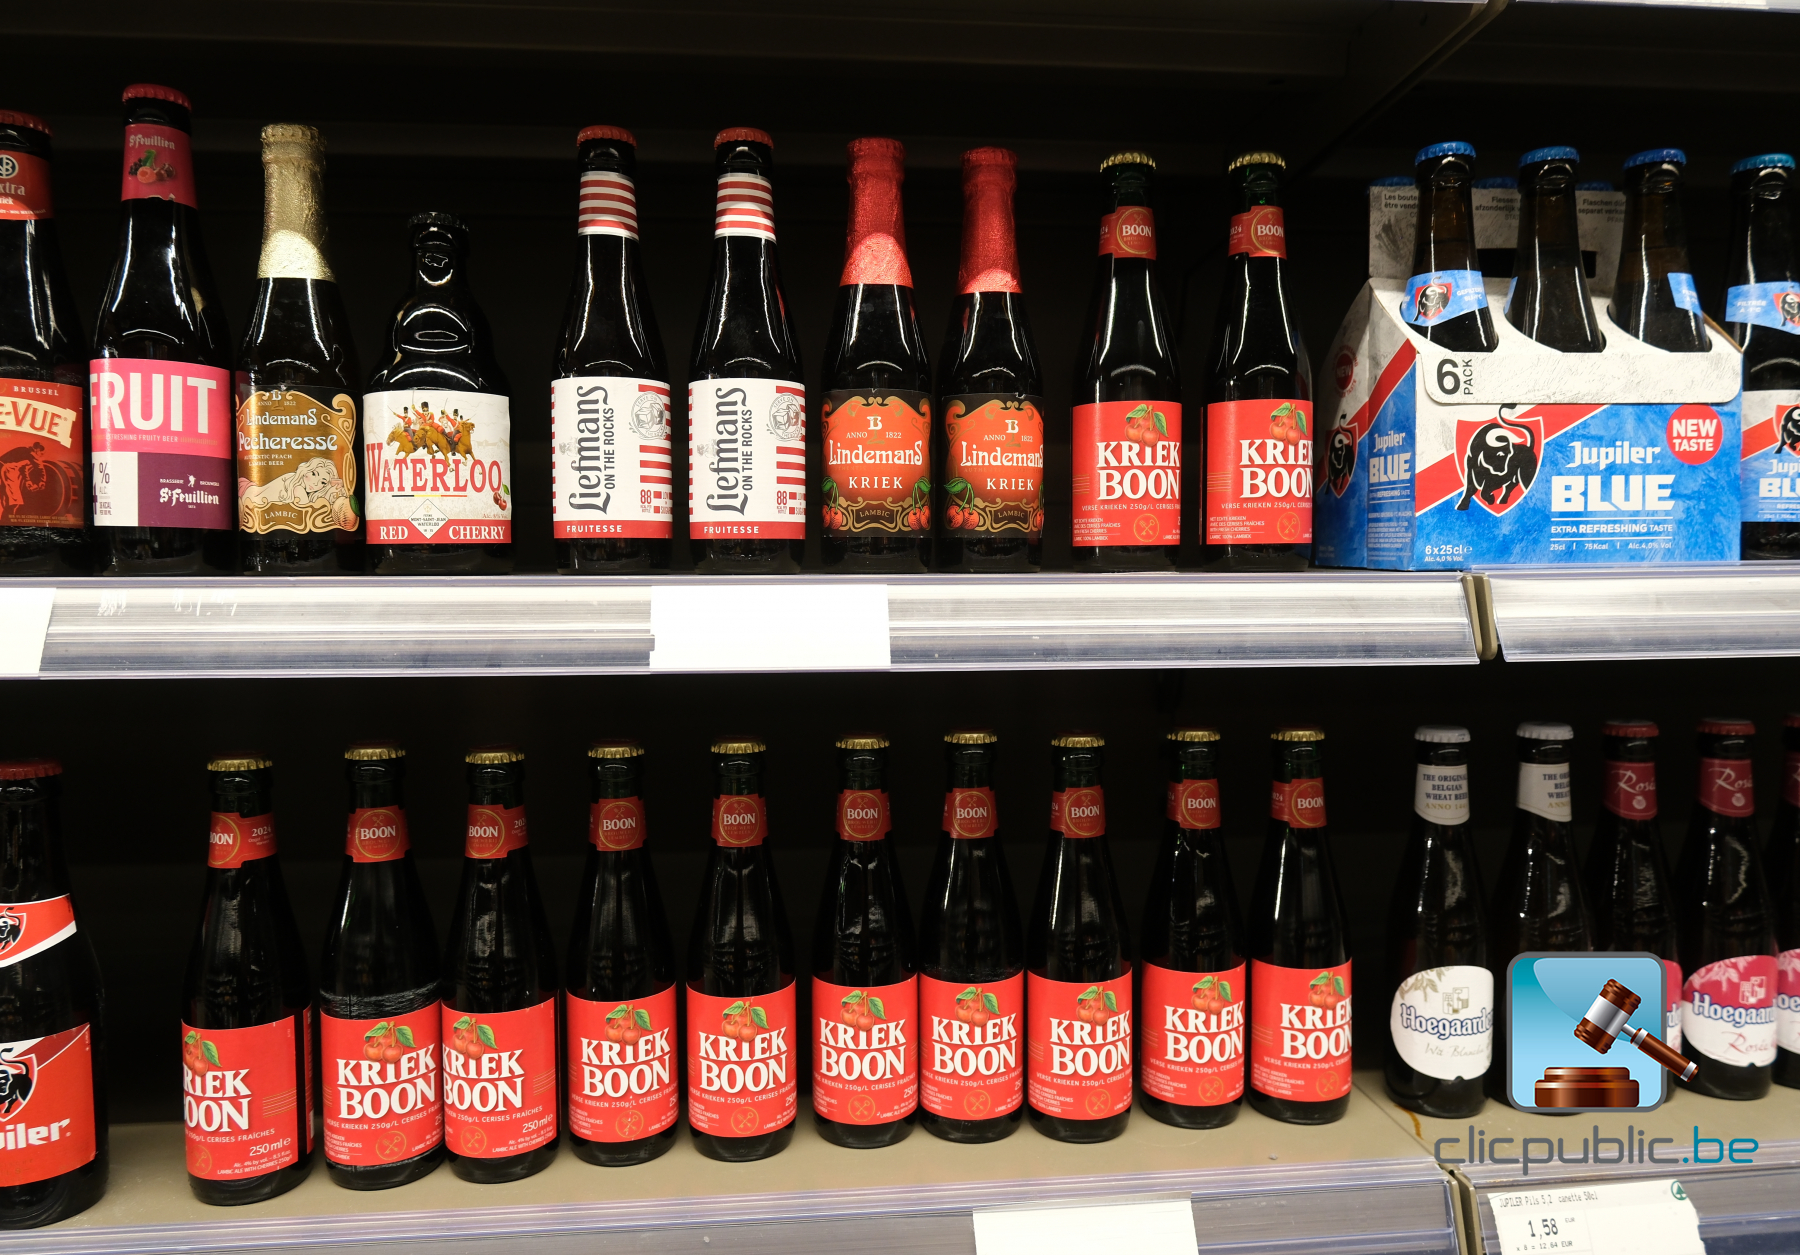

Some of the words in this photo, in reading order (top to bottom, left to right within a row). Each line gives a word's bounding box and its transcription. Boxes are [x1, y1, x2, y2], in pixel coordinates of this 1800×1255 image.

[1475, 205, 1516, 213] afzonderlijk
[1122, 224, 1151, 237] BOON
[1257, 224, 1284, 237] BOON
[1436, 359, 1461, 395] 6
[1463, 358, 1473, 395] PACK
[13, 386, 59, 396] BRUSSEL
[90, 372, 217, 434] FRUIT
[603, 407, 615, 445] ROCKS
[741, 409, 753, 447] ROCKS
[1672, 419, 1717, 437] NEW
[1373, 431, 1405, 453] Jupiler
[1673, 439, 1714, 452] TASTE
[569, 386, 611, 515] Liefmans
[706, 387, 748, 516] Liefmans
[1096, 441, 1180, 467] KRIEK
[1565, 441, 1661, 471] Jupiler
[366, 443, 502, 493] WATERLOO
[604, 450, 615, 471] THE
[742, 451, 753, 472] THE
[1369, 452, 1411, 484] BLUE
[604, 474, 616, 490] ON
[742, 475, 753, 491] ON
[848, 477, 903, 488] KRIEK
[987, 478, 1034, 490] KRIEK
[1097, 469, 1180, 500] BOON
[1759, 478, 1800, 497] BL
[171, 489, 219, 506] Feuillien
[640, 489, 652, 505] 88
[777, 490, 787, 505] 88
[1551, 474, 1676, 512] BLUE
[265, 511, 298, 519] LAMBIC
[859, 509, 890, 518] LAMBIC
[380, 526, 408, 540] RED
[449, 526, 505, 540] CHERRY
[567, 525, 622, 533] FRUITESSE
[704, 526, 759, 534] FRUITESSE
[1579, 524, 1647, 533] REFRESHING
[1649, 524, 1673, 532] TASTE
[1550, 543, 1565, 551] 25cl
[1423, 774, 1436, 782] THE
[1187, 797, 1216, 809] BOON
[1297, 796, 1324, 809] BOON
[1425, 793, 1452, 801] WHEAT
[847, 808, 879, 820] BOON
[956, 806, 988, 819] BOON
[1071, 804, 1100, 818] BOON
[1424, 802, 1451, 811] ANNO
[603, 817, 636, 831] BOON
[723, 813, 756, 825] BOON
[210, 832, 234, 845] OON
[361, 825, 396, 840] BOON
[469, 826, 499, 838] BOON
[1164, 1001, 1244, 1033] KRIEK
[819, 1017, 906, 1049] KRIEK
[931, 1013, 1017, 1045] KRIEK
[1049, 1010, 1130, 1045] KRIEK
[580, 1027, 670, 1066] KRIEK
[698, 1026, 788, 1062] KRIEK
[1164, 1026, 1243, 1064] BOON
[1280, 1019, 1352, 1060] BOON
[336, 1043, 437, 1086] KRIEK
[442, 1043, 525, 1079] KRIEK
[820, 1043, 906, 1081] BOON
[932, 1038, 1017, 1077] BOON
[1050, 1036, 1130, 1077] BOON
[699, 1052, 788, 1094] BOON
[1167, 1064, 1193, 1073] KRIEKEN
[1284, 1061, 1311, 1069] KRIEKEN
[582, 1053, 671, 1098] BOON
[935, 1075, 959, 1085] KRIEKEN
[960, 1079, 984, 1087] 250g/L
[986, 1075, 1009, 1085] CERISES
[1036, 1072, 1051, 1082] VERSE
[1053, 1077, 1080, 1086] KRIEKEN
[1107, 1073, 1124, 1084] CERISES
[443, 1070, 525, 1112] BOON
[822, 1078, 843, 1089] KRIEKEN
[844, 1083, 869, 1092] 250g/L
[871, 1081, 896, 1091] CERISES
[337, 1070, 437, 1119] BOON
[585, 1099, 609, 1108] KRIEKEN
[639, 1092, 662, 1105] CERISES
[702, 1093, 725, 1103] KRIEKEN
[727, 1096, 752, 1104] 250g/L
[754, 1090, 779, 1102] CERISES
[184, 1092, 252, 1132] OON
[482, 1115, 510, 1123] CERISES
[512, 1105, 543, 1120] FRAÎCHES
[341, 1122, 369, 1130] KRIEKEN
[371, 1121, 399, 1130] 250g/L
[401, 1111, 427, 1125] CERISES
[522, 1121, 539, 1133] 250
[238, 1128, 275, 1142] FRAÎCHES
[249, 1143, 270, 1156] 250
[244, 1165, 257, 1173] WITH
[1525, 1196, 1539, 1206] Pils
[1541, 1195, 1553, 1206] 5,2
[1558, 1193, 1582, 1203] canette
[1584, 1191, 1598, 1201] 50cl
[1527, 1218, 1559, 1240] 1,58
[1539, 1241, 1558, 1250] 12,64
[1561, 1240, 1573, 1248] EUR
